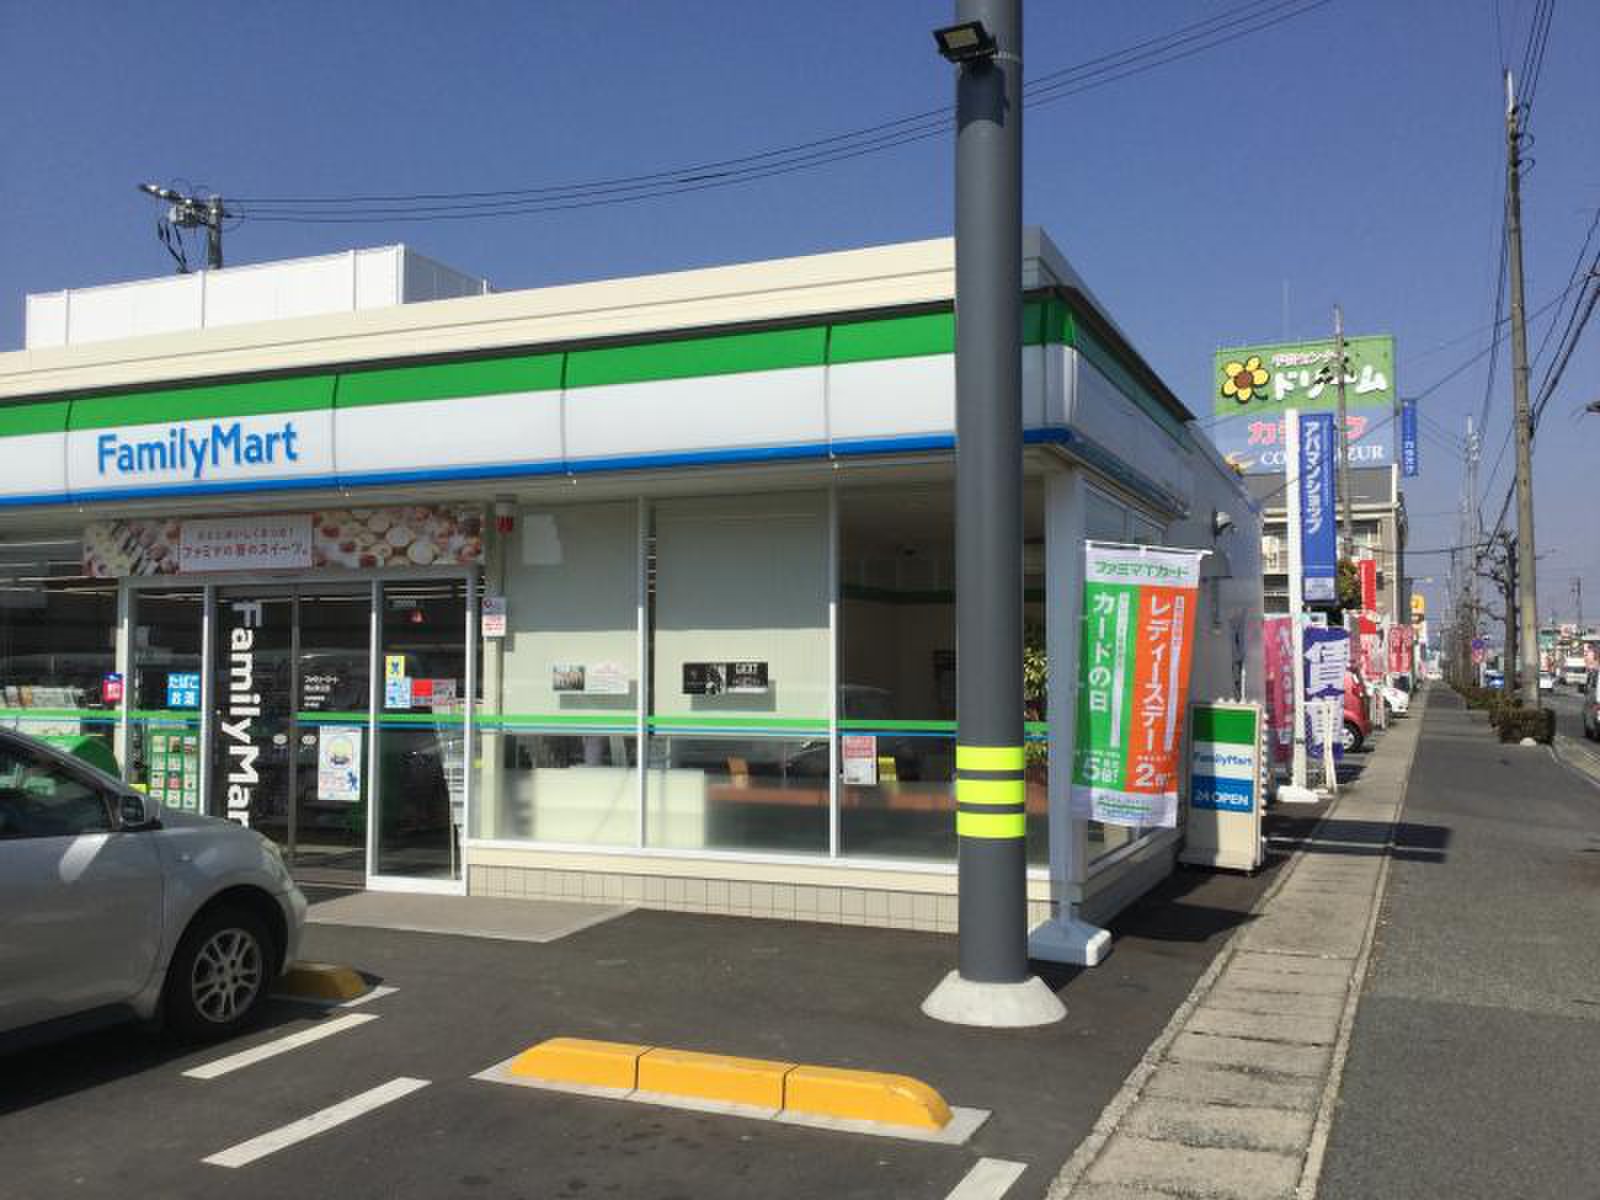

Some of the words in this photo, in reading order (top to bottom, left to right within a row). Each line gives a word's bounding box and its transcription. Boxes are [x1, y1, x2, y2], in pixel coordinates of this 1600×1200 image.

[98, 422, 298, 480] FamilyMart
[1304, 421, 1323, 534] アパマンショップ
[1094, 560, 1190, 578] ファミマTカード
[167, 671, 200, 689] たばこ
[1088, 591, 1115, 713] カードの日
[1140, 594, 1172, 752] レディースデー
[220, 602, 262, 829] FamilyMar
